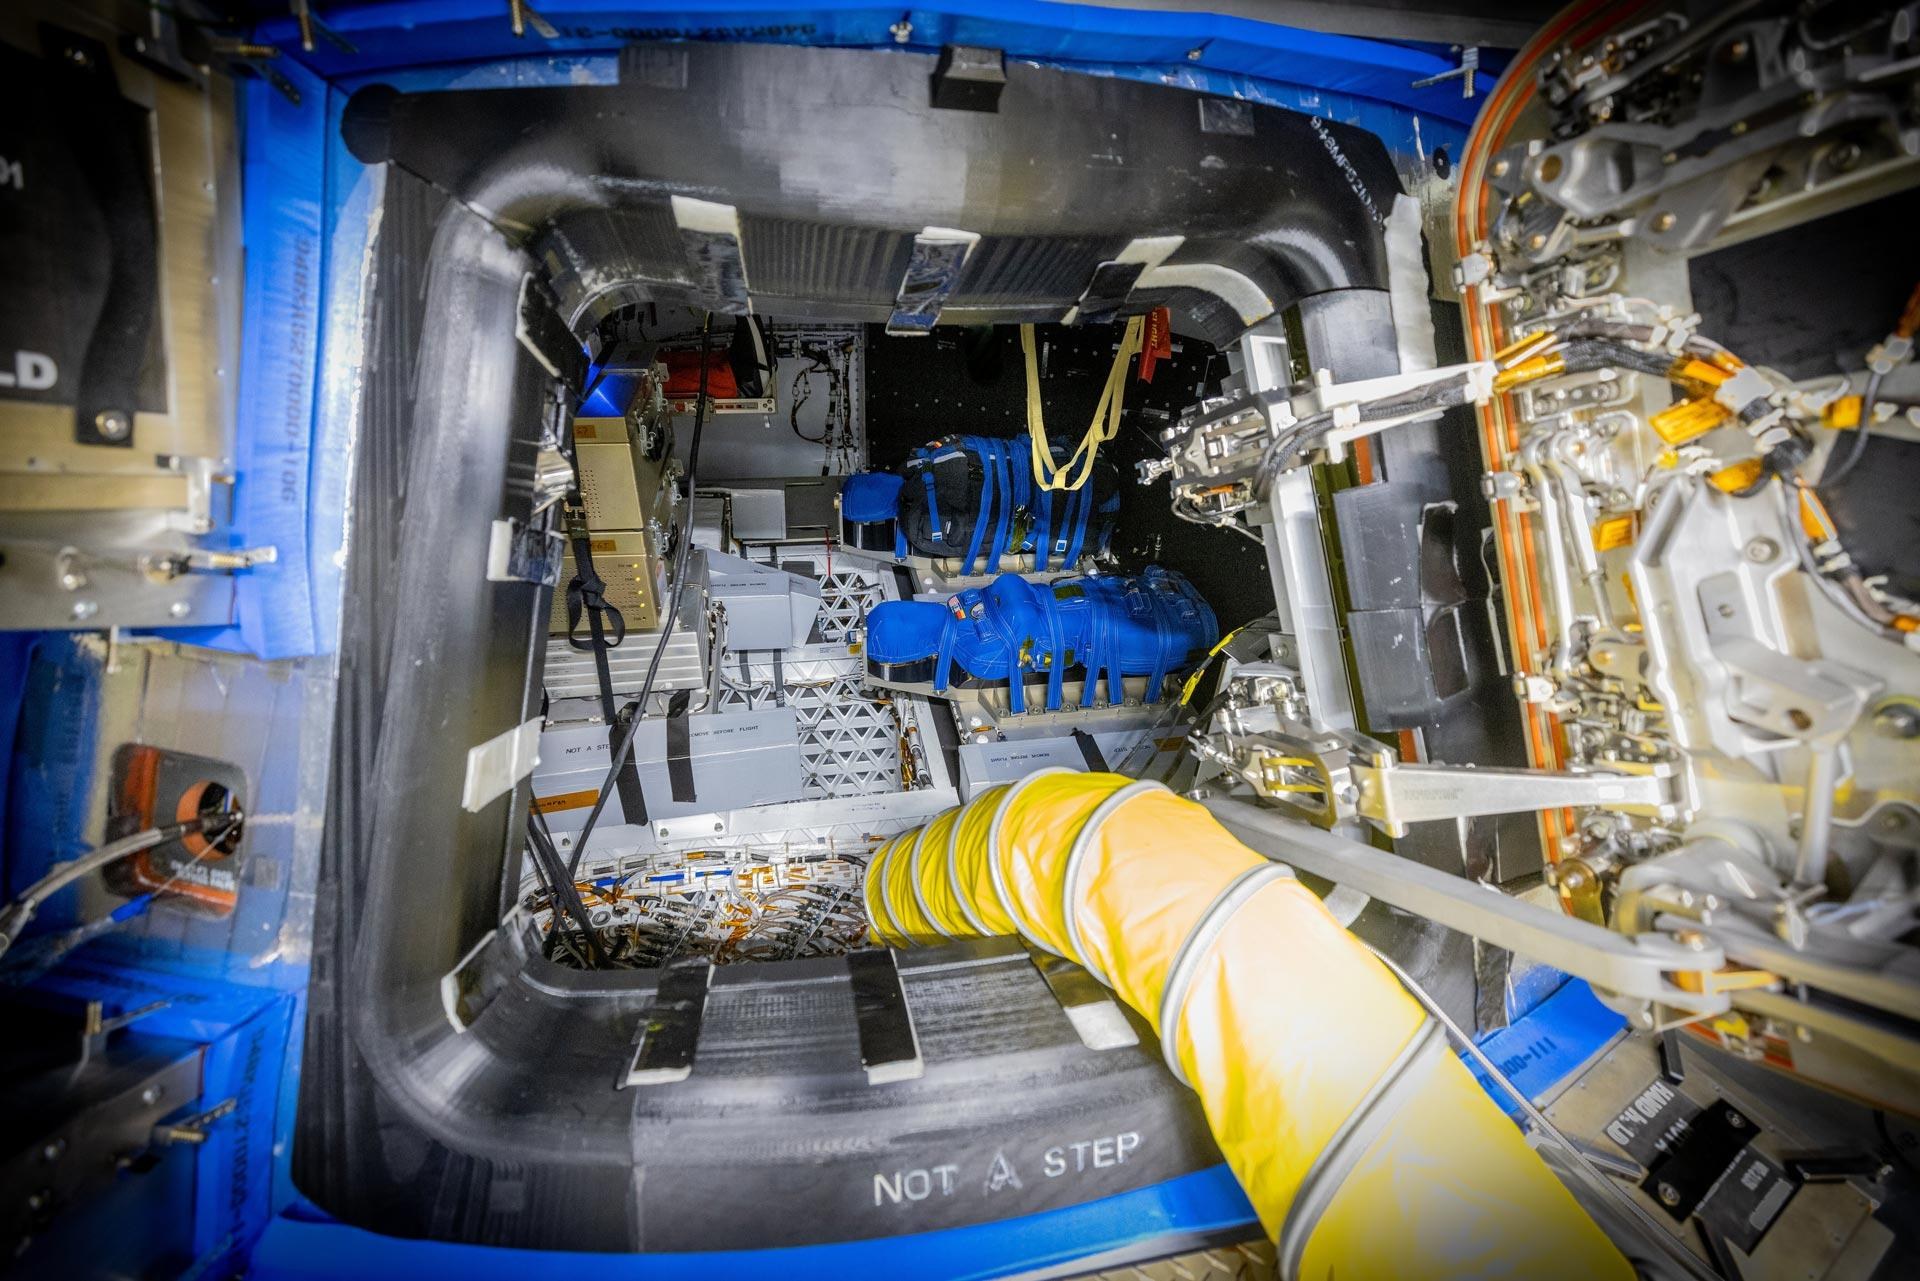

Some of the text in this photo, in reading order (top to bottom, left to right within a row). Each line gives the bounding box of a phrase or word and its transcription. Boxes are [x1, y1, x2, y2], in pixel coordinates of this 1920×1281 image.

[566, 746, 581, 754] NOT
[1634, 1081, 1675, 1118] HAND
[873, 1131, 1140, 1206] NOT A STEP
